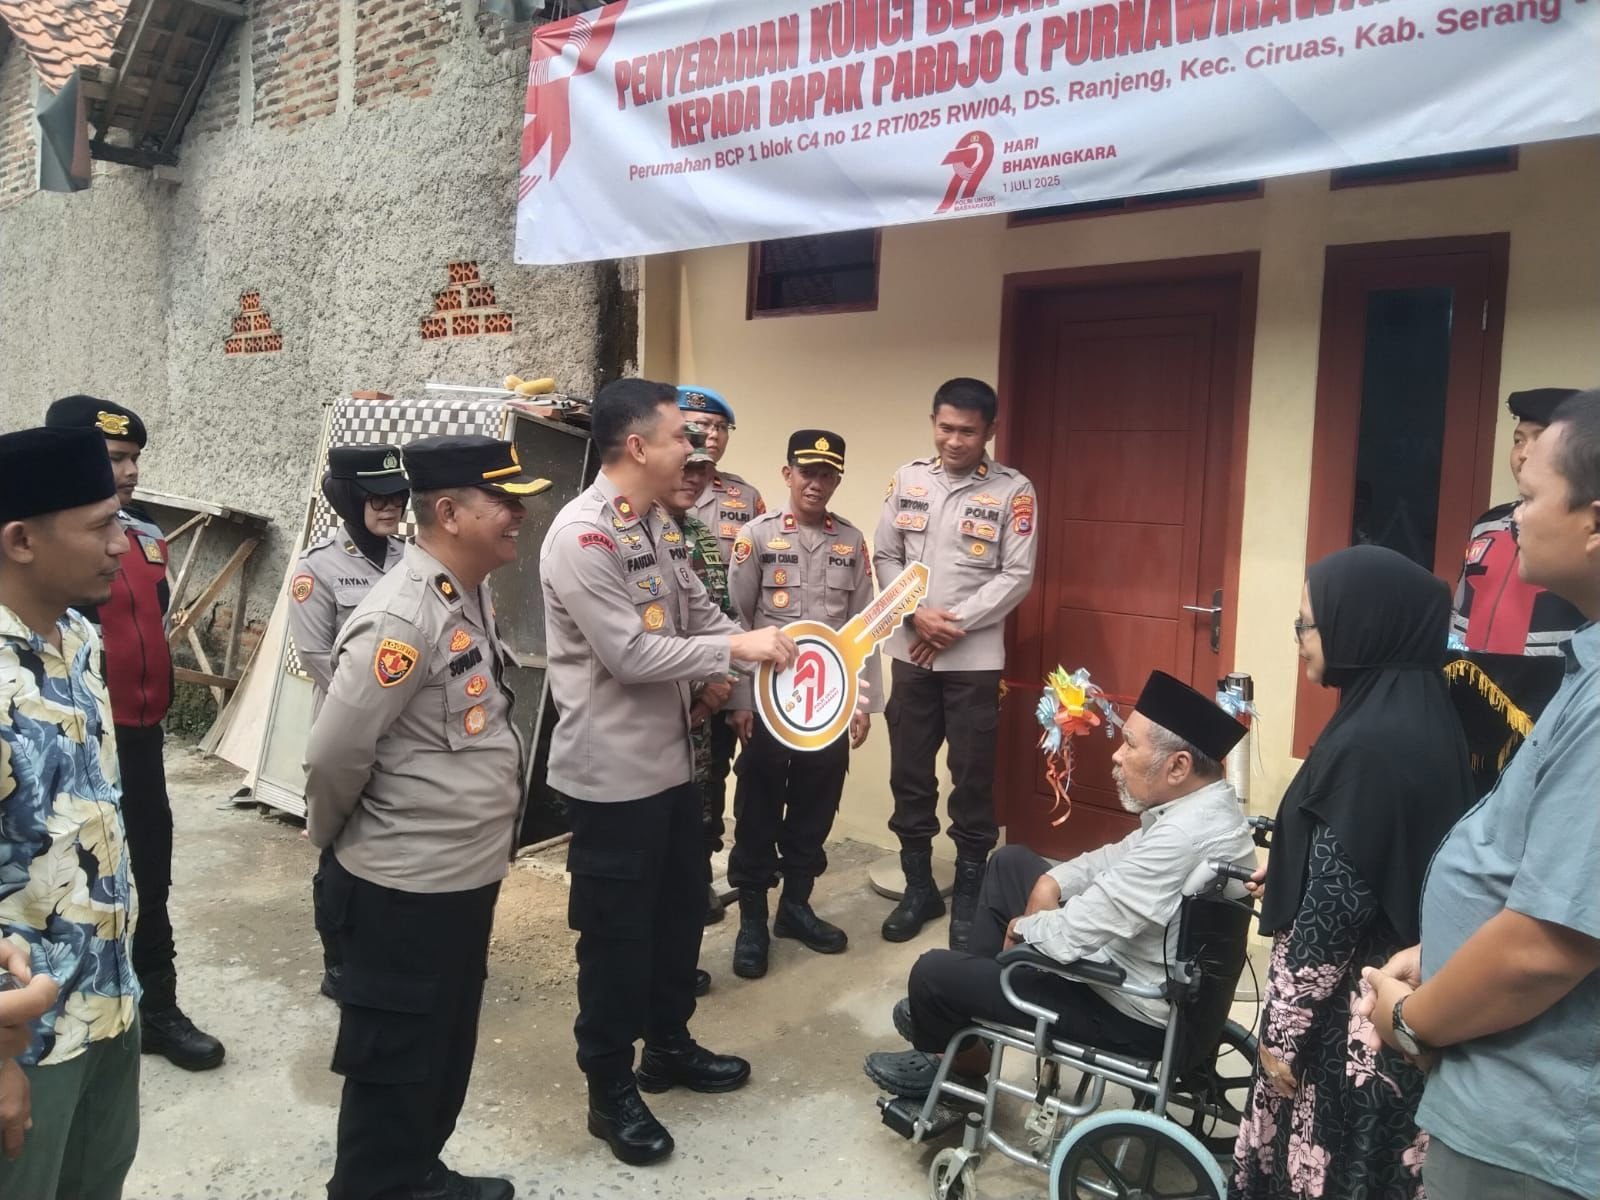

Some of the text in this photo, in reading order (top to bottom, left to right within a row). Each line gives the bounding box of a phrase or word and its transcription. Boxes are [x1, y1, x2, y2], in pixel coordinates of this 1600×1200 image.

[614, 13, 800, 110] PENYERAHAN
[809, 0, 914, 64] KUNCI
[629, 0, 1561, 181] Perumahan BCP 1 blok C4 no 12 RT/025 RW/04, DS. Ranjeng, Kec. Ciruas, Kab. Serang
[668, 85, 761, 148] KEPADA
[769, 61, 865, 126] BAPAK
[872, 29, 1005, 106] PARDJO
[1014, 22, 1032, 76] (
[1002, 144, 1117, 174] BHAYANGKARA
[1003, 137, 1039, 154] HARI
[1003, 175, 1061, 193] 1 JULI 2025
[965, 507, 1000, 521] POLRI
